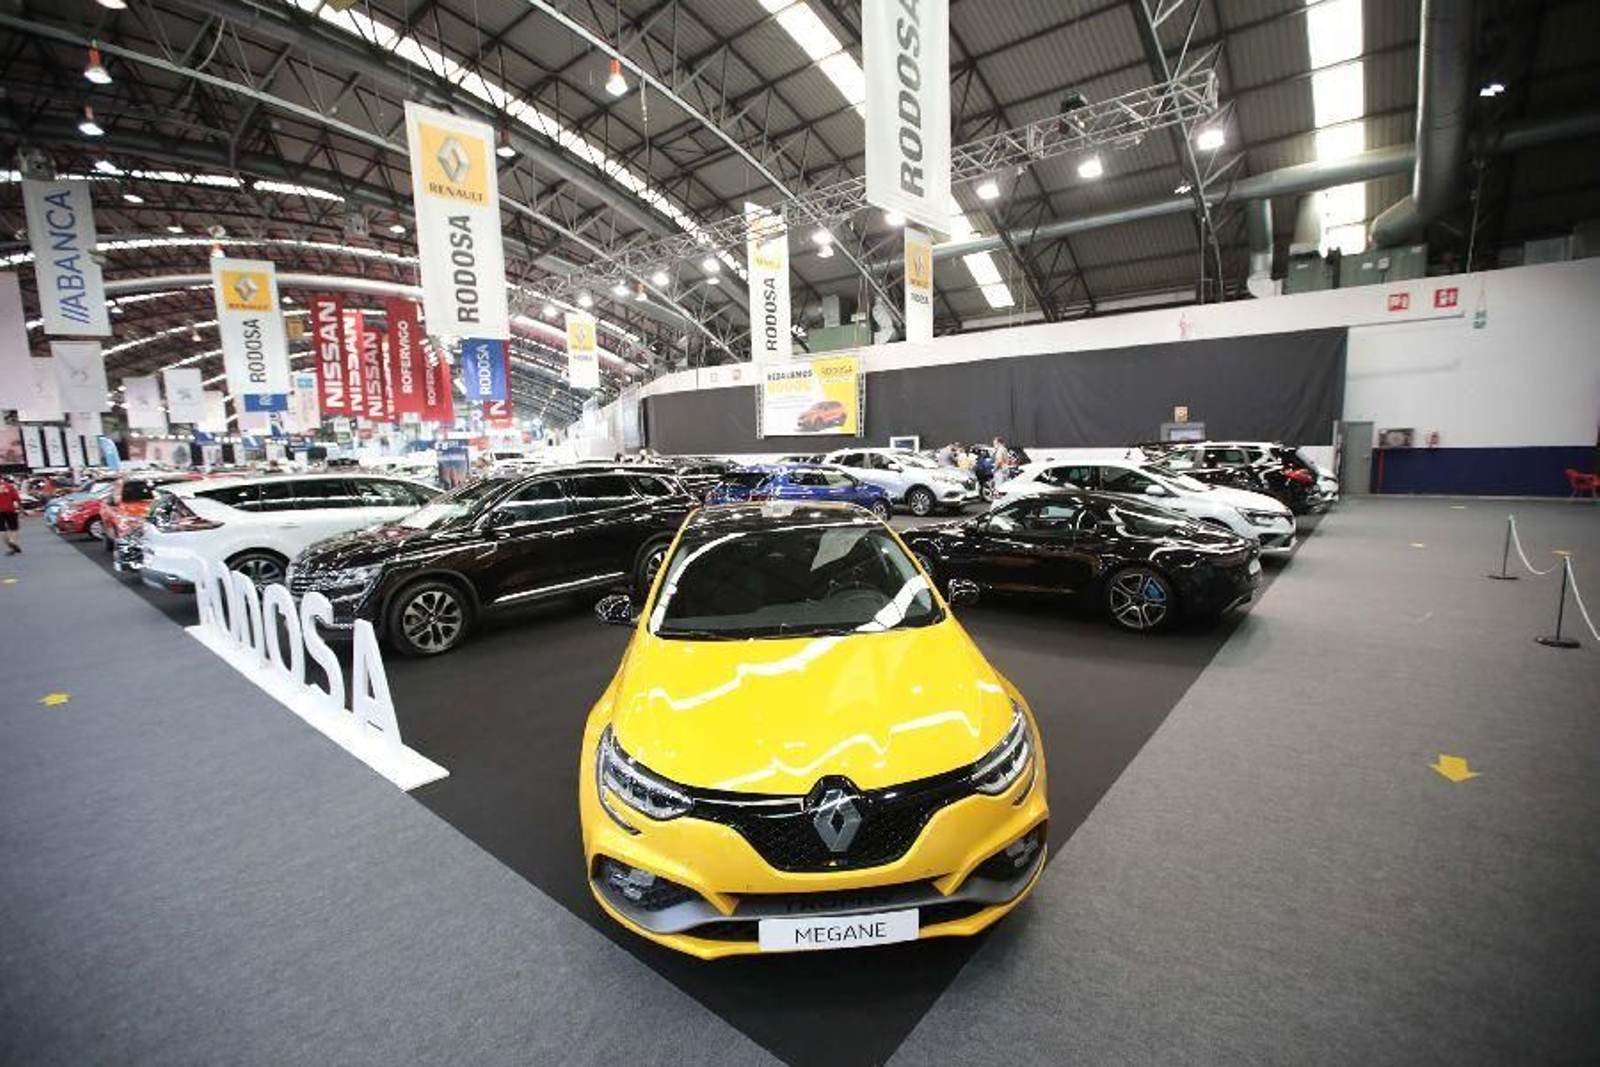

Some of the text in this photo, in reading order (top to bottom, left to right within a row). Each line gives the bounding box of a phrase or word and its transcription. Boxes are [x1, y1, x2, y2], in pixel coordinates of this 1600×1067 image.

[429, 182, 483, 203] RENAULT
[448, 215, 480, 323] RODOSA
[764, 278, 777, 350] RODOSA
[242, 319, 266, 383] RODOSA
[318, 302, 345, 407] NISSAN
[342, 316, 363, 411] NISSAN
[363, 332, 384, 416] NISSAN
[476, 343, 492, 395] RODOSA
[795, 922, 887, 944] MEGANE
